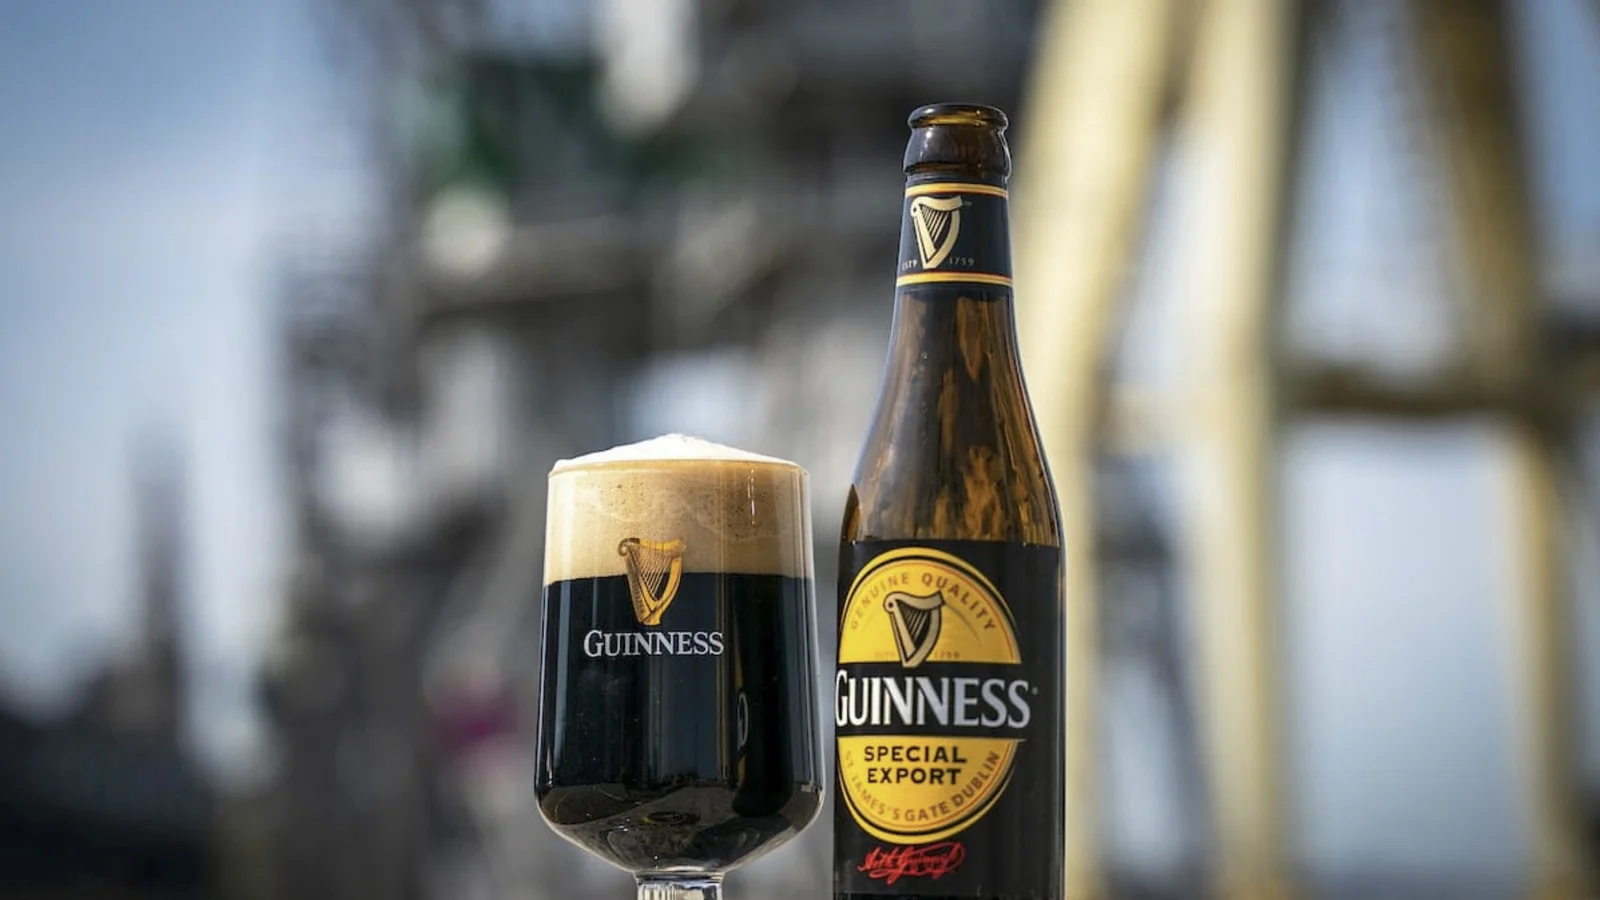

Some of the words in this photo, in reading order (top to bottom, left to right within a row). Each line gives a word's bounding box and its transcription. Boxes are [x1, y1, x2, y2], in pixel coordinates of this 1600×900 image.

[949, 257, 975, 267] 1759
[851, 572, 910, 630] GENUINE
[921, 572, 997, 632] QUALITY
[583, 629, 725, 658] GUINNESS
[835, 669, 1032, 729] GUINNESS
[864, 746, 967, 764] SPECIAL
[867, 768, 962, 785] EXPORT
[904, 801, 951, 823] GATE
[951, 751, 1001, 808] DUBLIN
